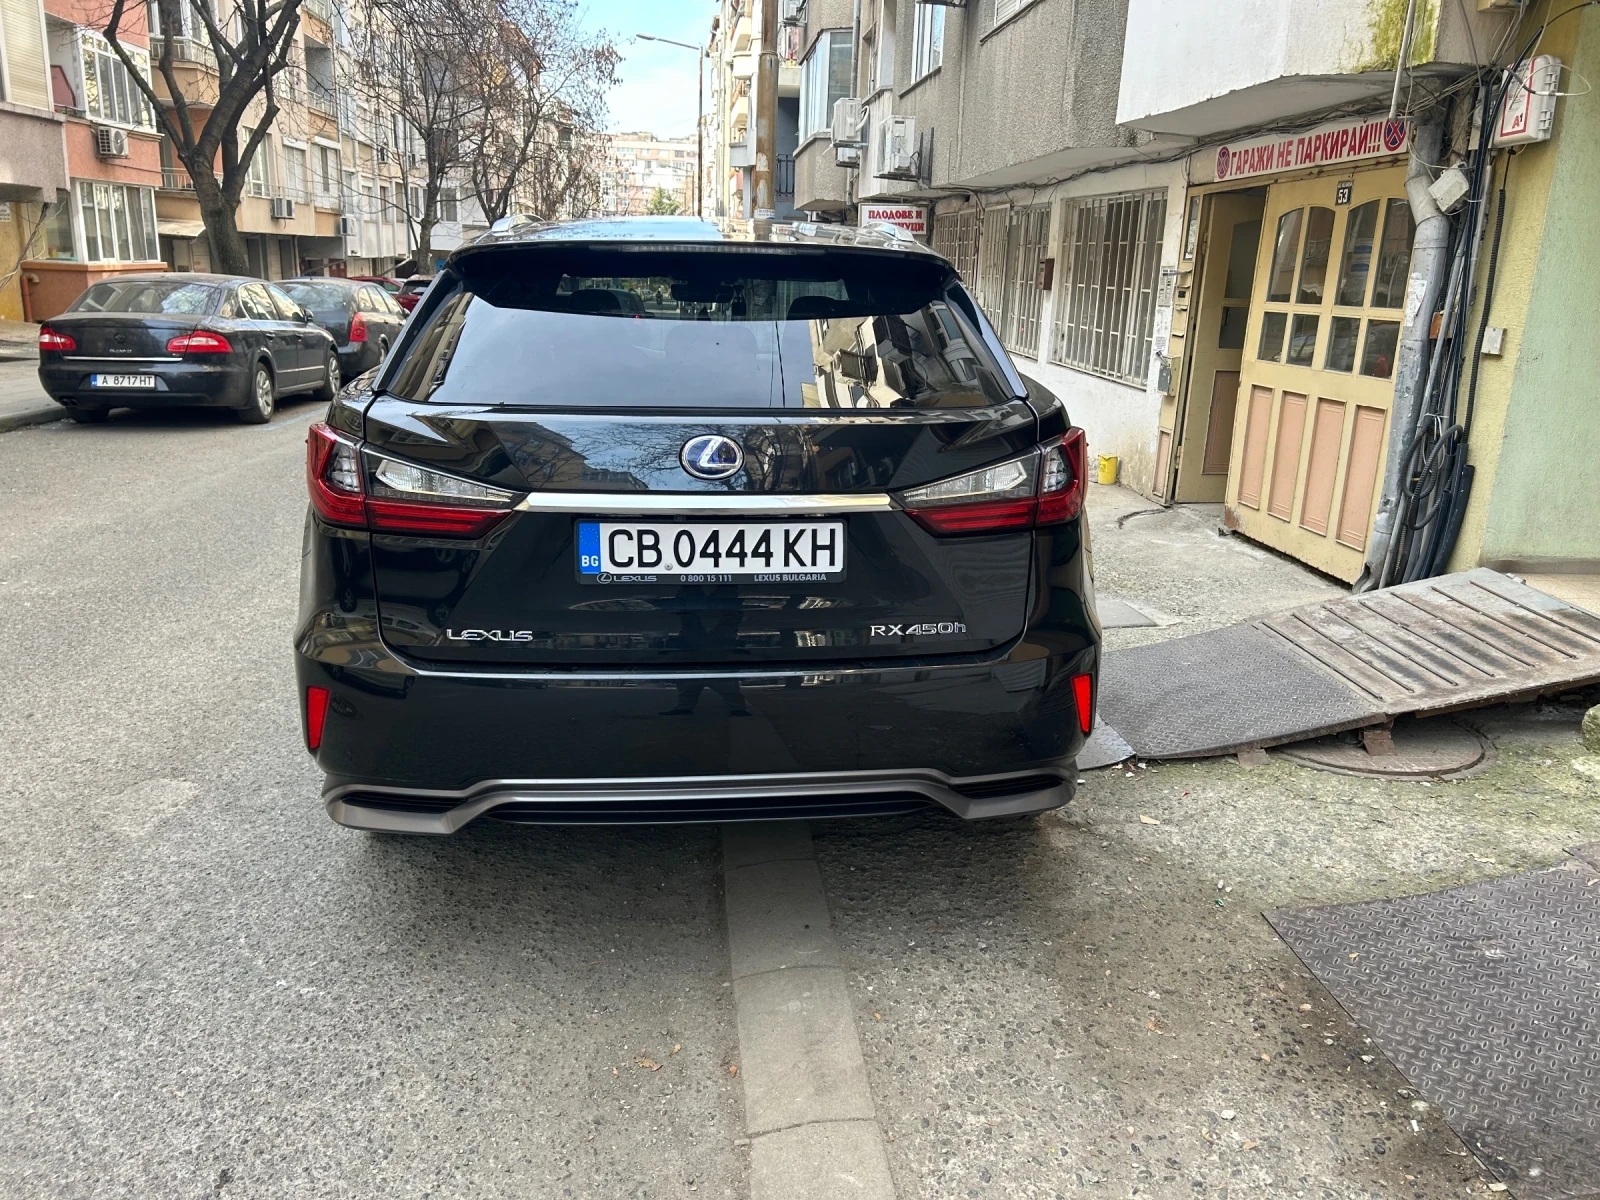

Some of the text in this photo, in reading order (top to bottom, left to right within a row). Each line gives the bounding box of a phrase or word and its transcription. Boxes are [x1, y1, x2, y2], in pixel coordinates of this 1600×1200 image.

[1230, 117, 1383, 176] ГАРАЖИ НЕ ПАРКИРАЙ!!!
[1337, 188, 1349, 204] 53
[868, 210, 923, 220] ПЛОДОВЕ И
[608, 528, 663, 568] CB
[673, 528, 774, 568] 0444
[581, 555, 599, 567] BG
[613, 574, 657, 582] LEXUS
[687, 574, 704, 582] 800
[707, 574, 716, 582] 15
[719, 574, 732, 582] 111
[754, 574, 781, 582] LEXUS
[782, 573, 827, 582] BULGARIA
[446, 628, 533, 642] LEXUS
